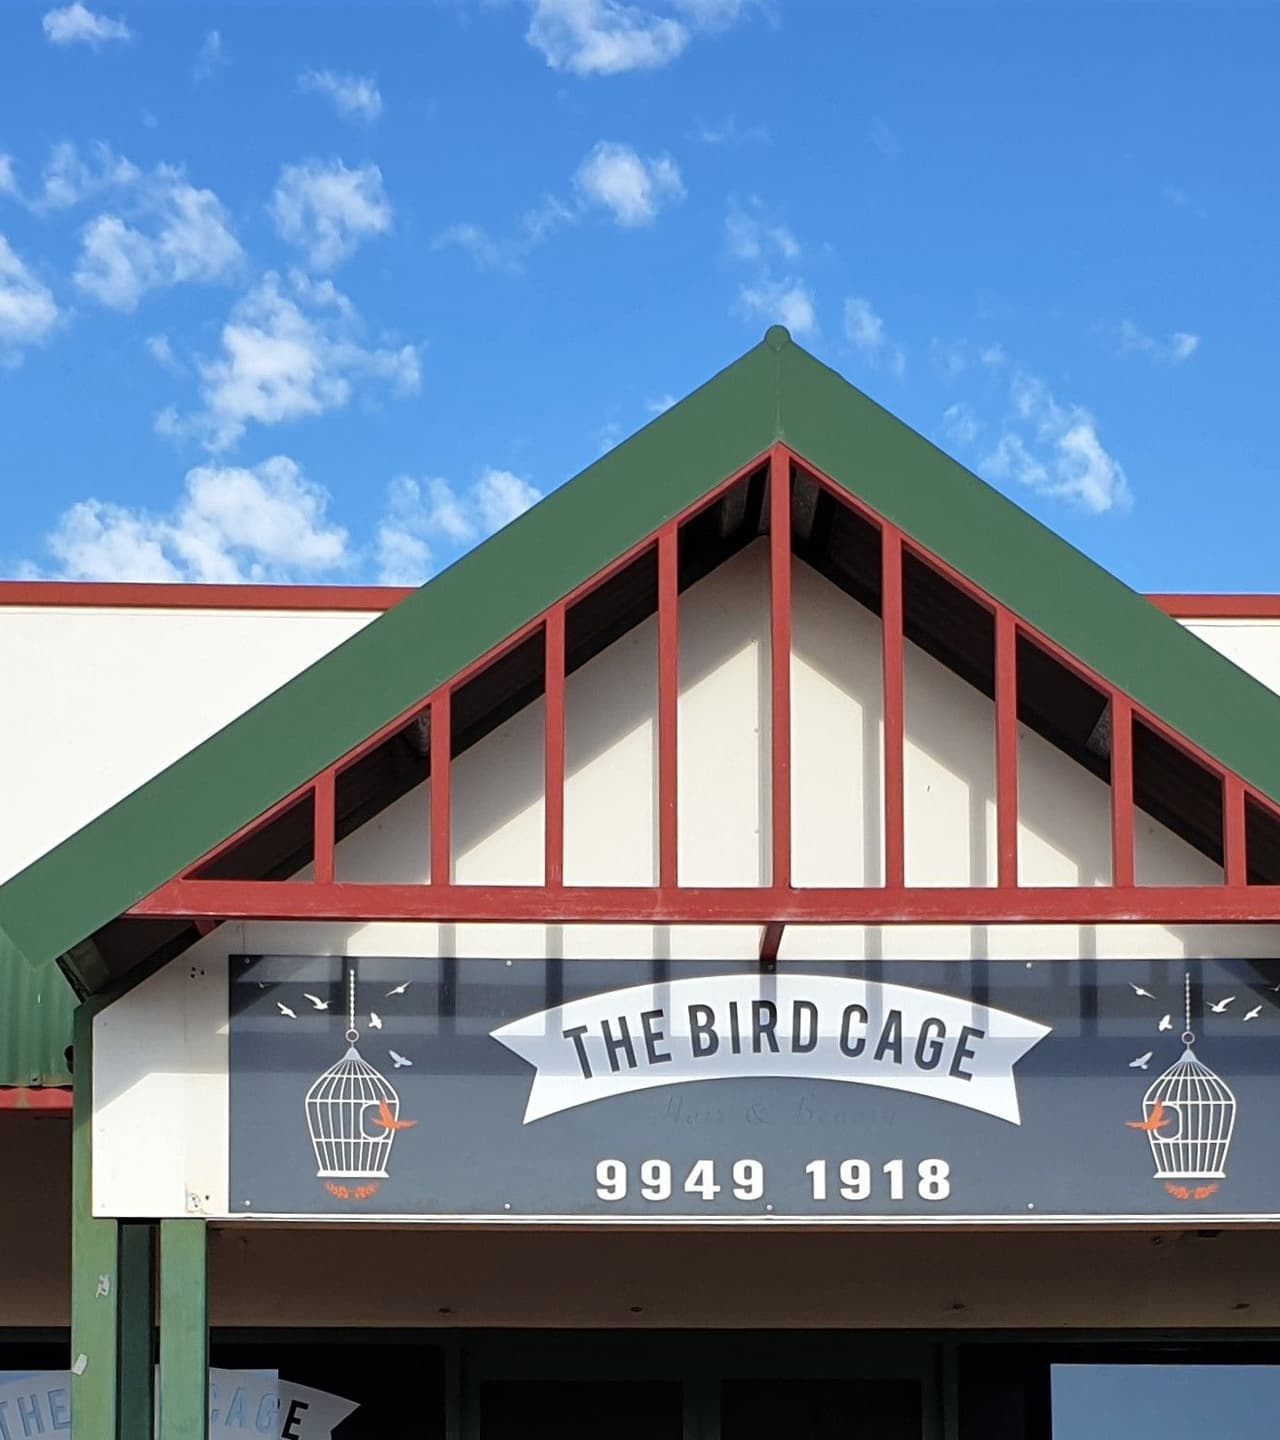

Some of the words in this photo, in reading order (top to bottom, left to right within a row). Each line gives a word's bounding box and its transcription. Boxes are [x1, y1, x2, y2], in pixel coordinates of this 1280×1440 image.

[562, 1008, 672, 1080] THE
[687, 1000, 819, 1058] BIRD
[838, 1004, 986, 1082] CAGE
[595, 1159, 765, 1201] 9949
[806, 1159, 951, 1201] 1918
